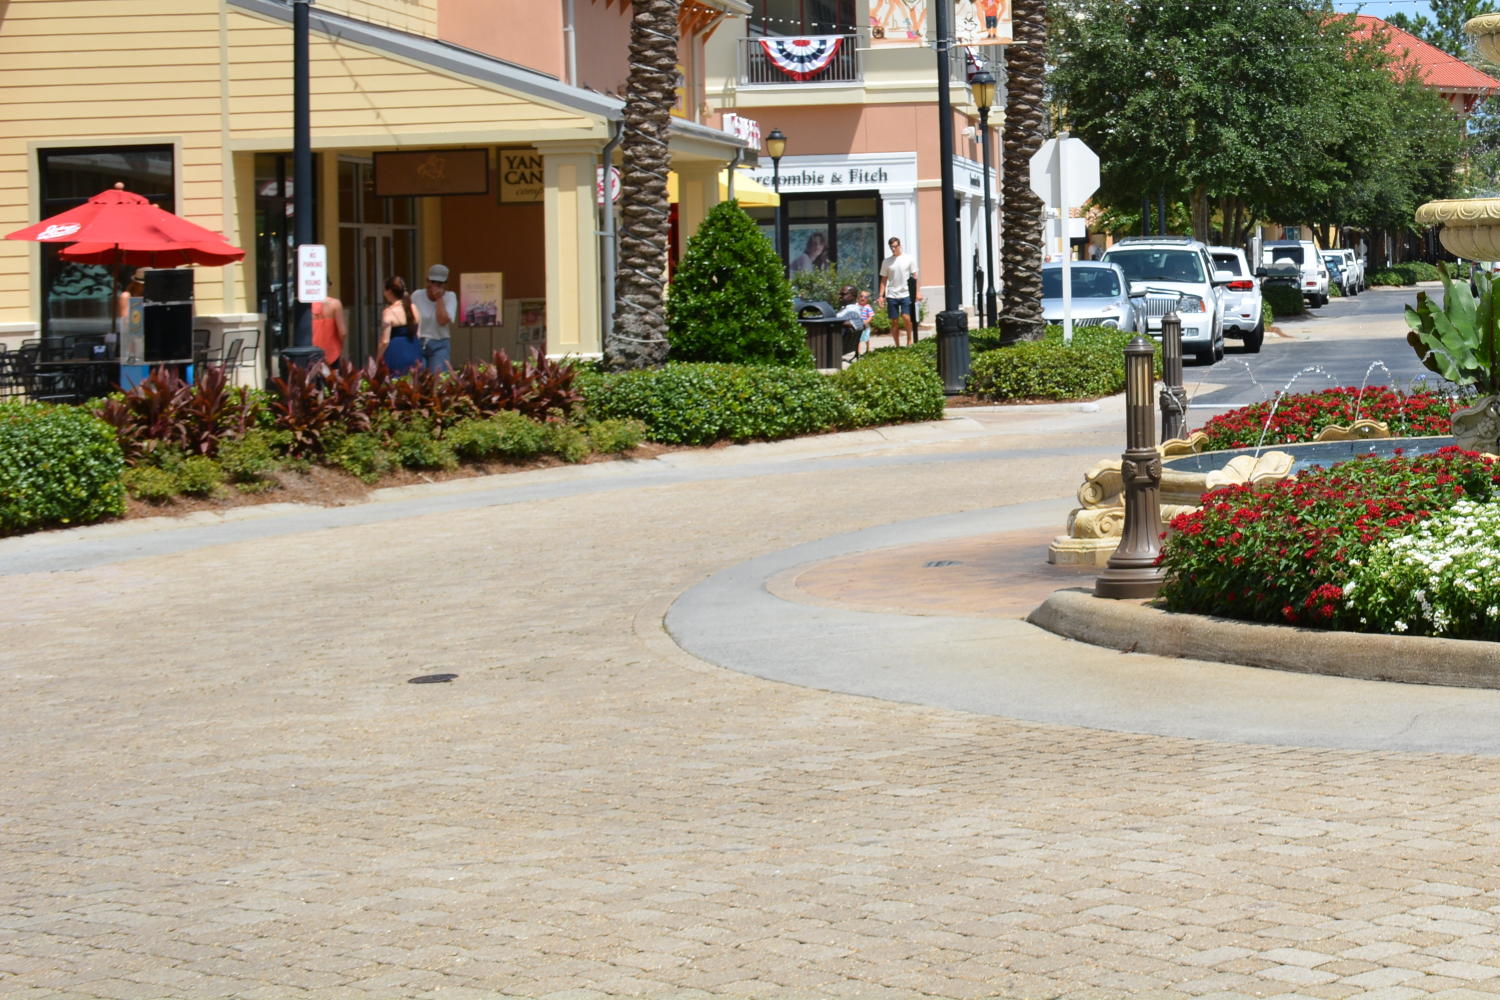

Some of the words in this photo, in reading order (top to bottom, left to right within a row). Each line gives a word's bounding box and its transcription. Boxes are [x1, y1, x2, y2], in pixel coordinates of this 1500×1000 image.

[504, 155, 545, 169] YAN
[504, 171, 545, 185] CAN
[830, 173, 842, 185] &
[848, 167, 888, 184] Fitch
